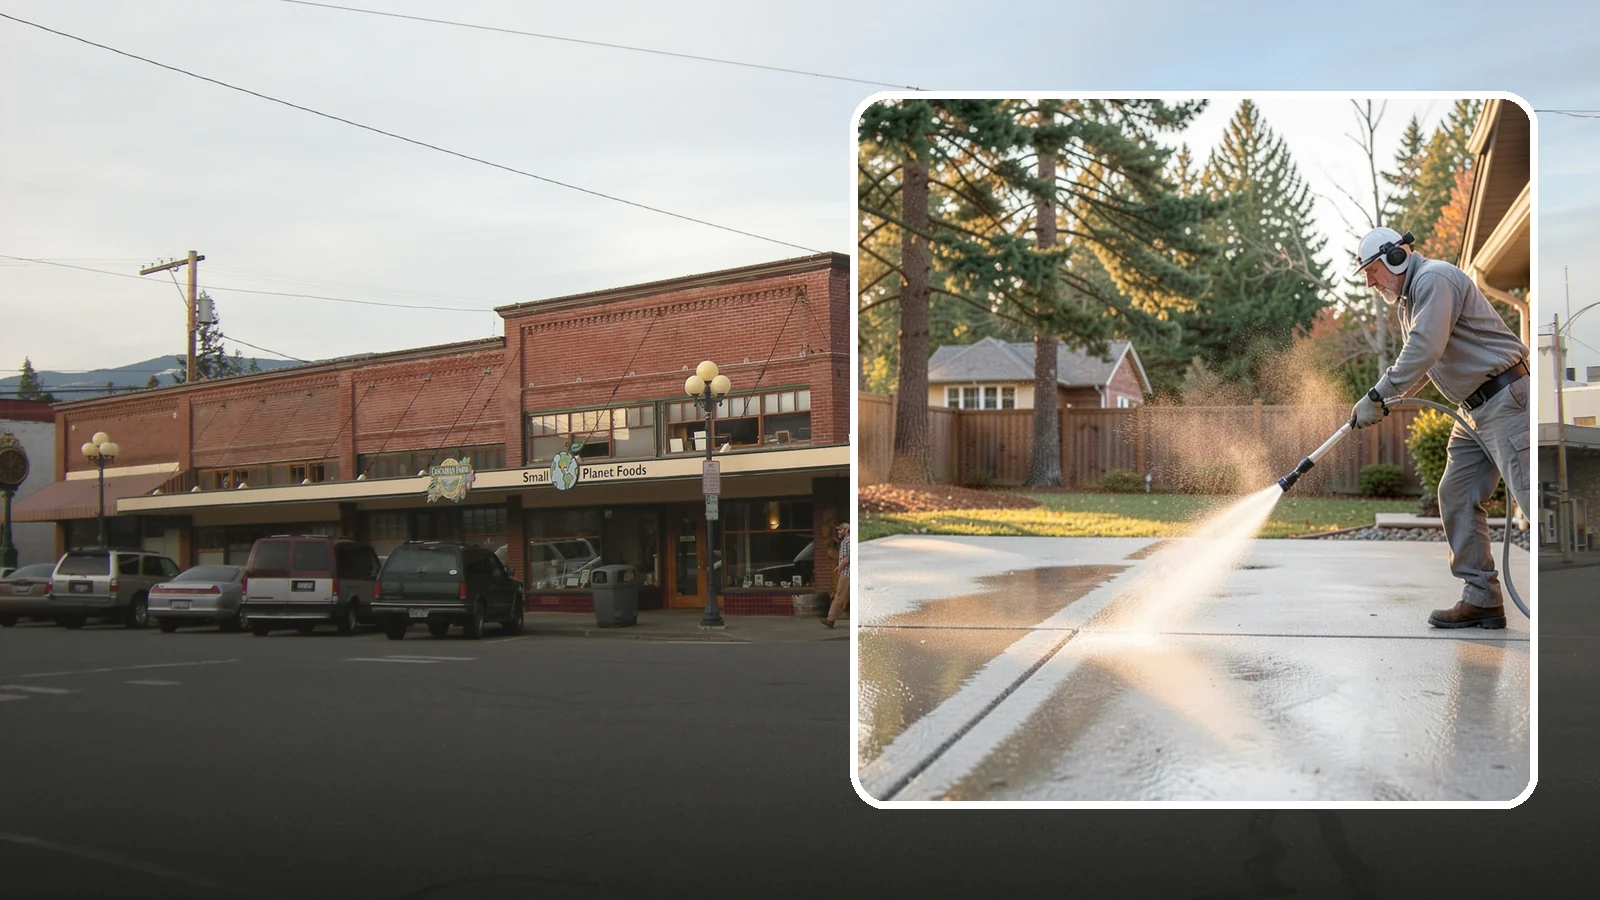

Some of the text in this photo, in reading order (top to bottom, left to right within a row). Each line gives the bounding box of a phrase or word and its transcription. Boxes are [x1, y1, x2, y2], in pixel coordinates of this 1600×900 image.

[523, 464, 647, 482] Small Planet Foods
